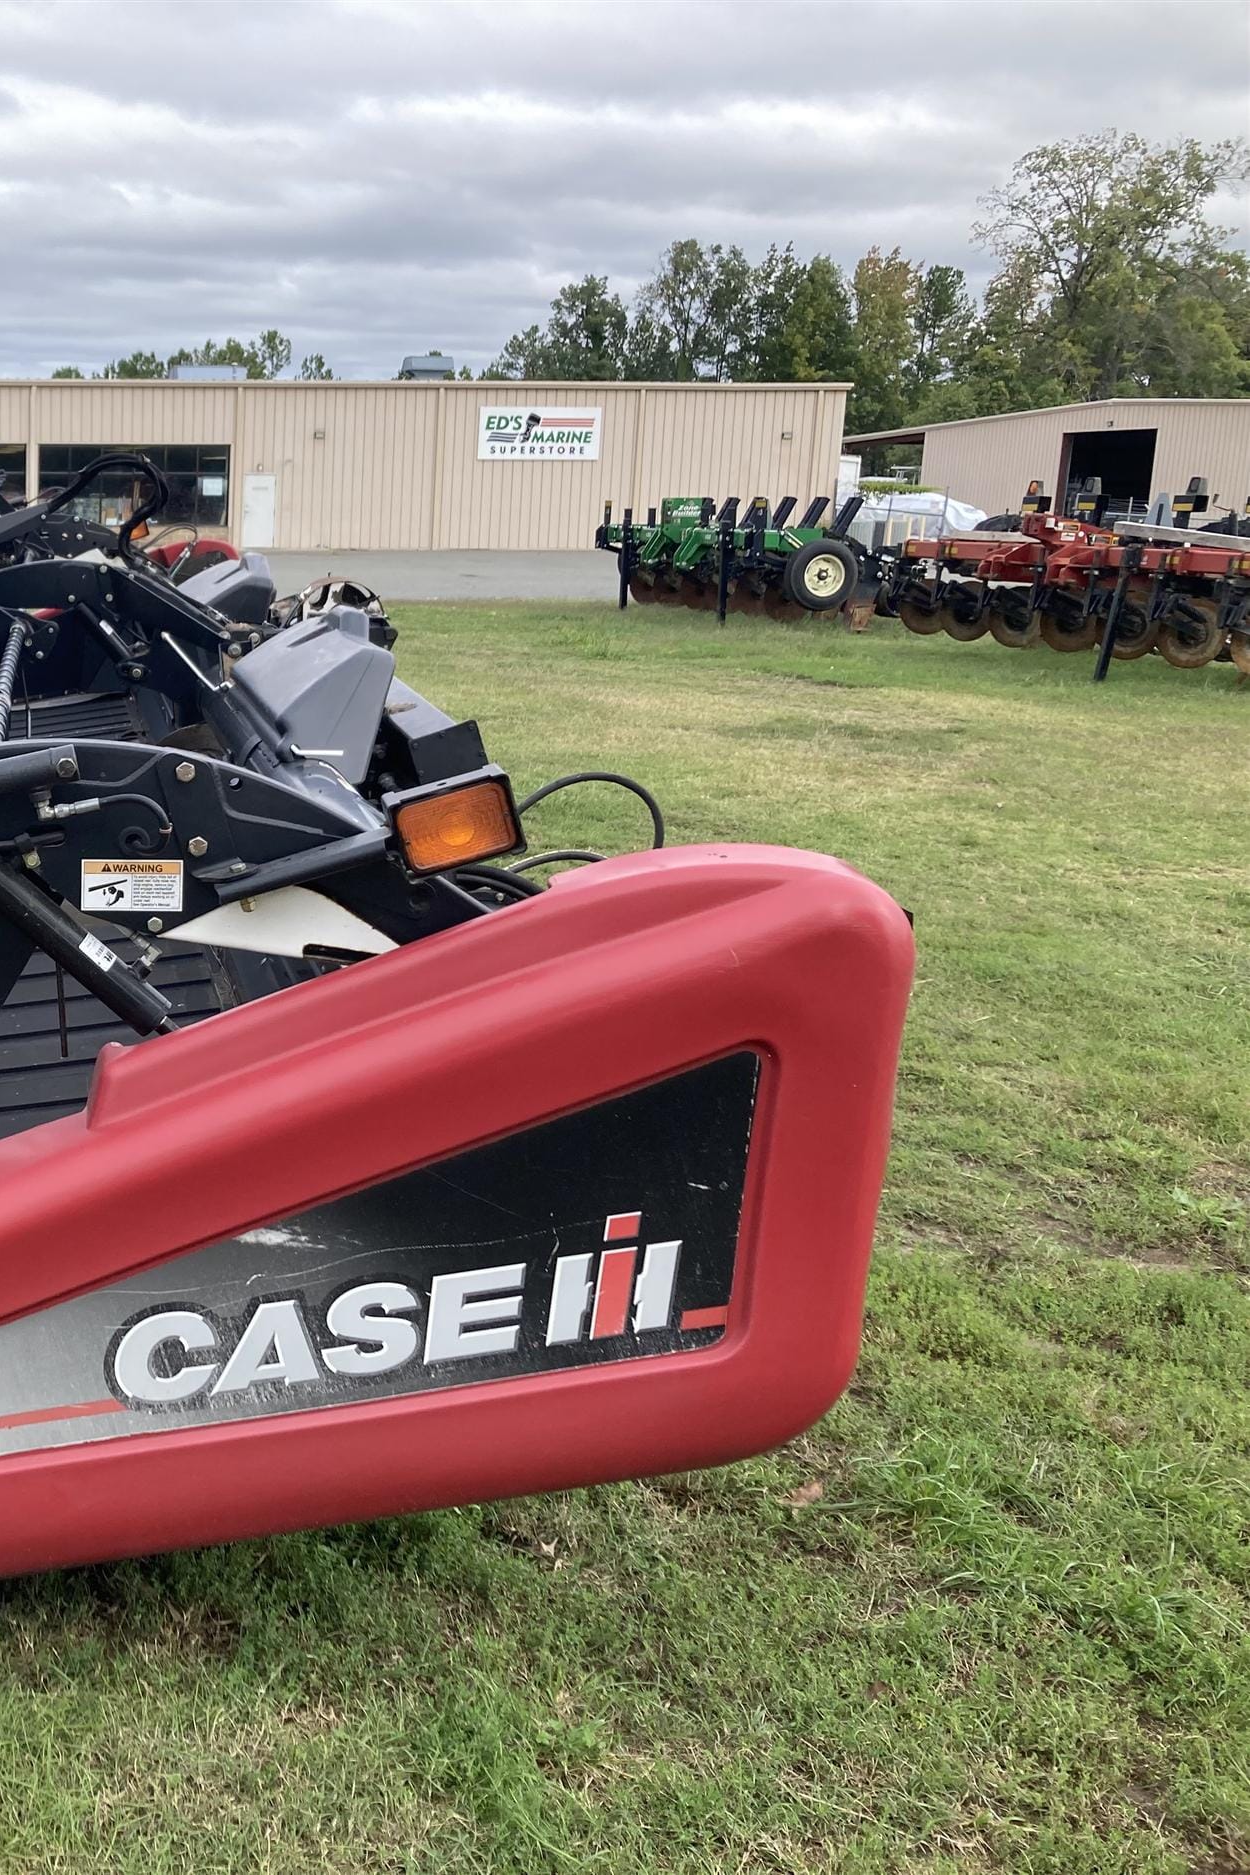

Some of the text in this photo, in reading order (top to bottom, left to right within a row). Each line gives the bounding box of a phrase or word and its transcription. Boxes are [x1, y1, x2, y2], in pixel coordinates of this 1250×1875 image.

[485, 415, 523, 431] ED'S
[531, 431, 593, 444] MARINE
[490, 446, 585, 455] SUPERSTORE
[113, 864, 163, 873] WARNING
[108, 1262, 528, 1404] CASE
